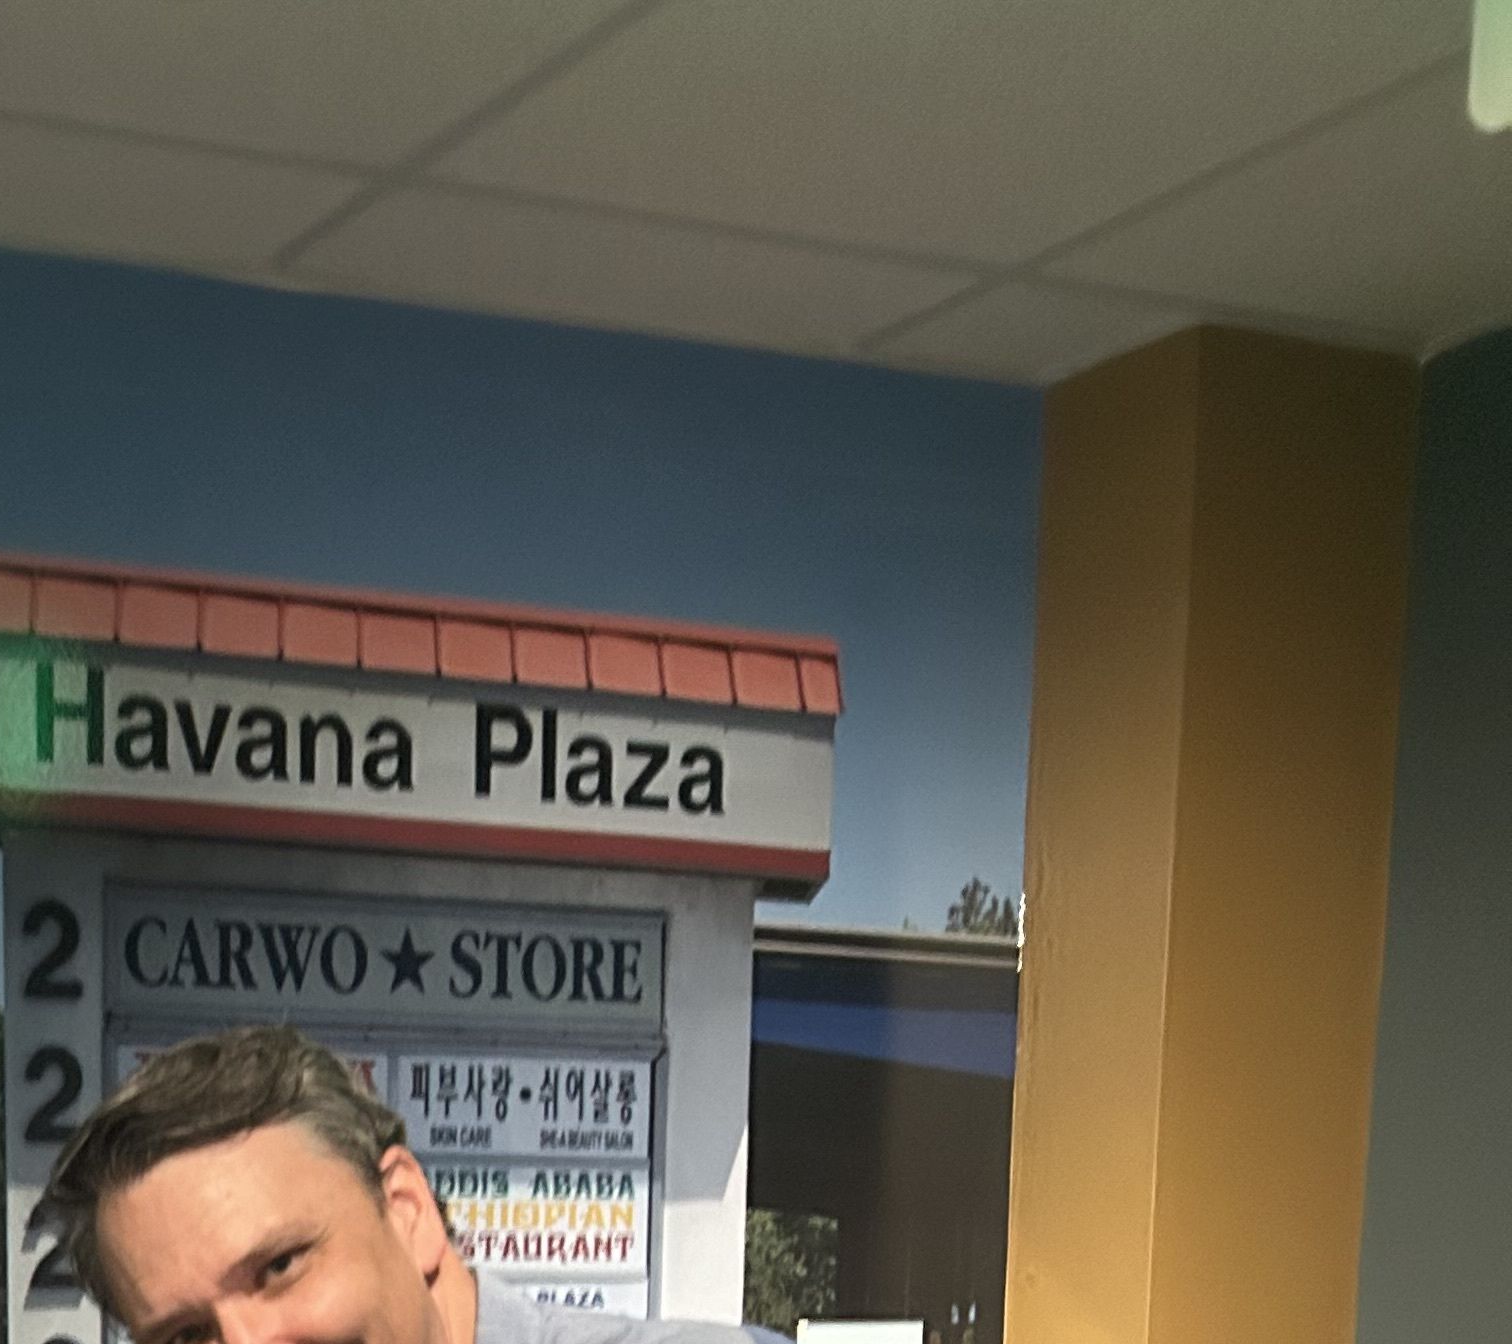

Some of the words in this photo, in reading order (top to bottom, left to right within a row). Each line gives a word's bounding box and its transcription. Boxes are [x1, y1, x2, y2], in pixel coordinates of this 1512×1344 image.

[34, 661, 416, 792] Havana
[472, 702, 726, 817] Plaza
[21, 899, 84, 1000] 2
[123, 914, 368, 995] CARWO
[447, 937, 644, 1004] STORE
[24, 1045, 83, 1144] 2
[434, 1168, 509, 1199] DDIS
[532, 1170, 634, 1199] ABABA
[445, 1201, 634, 1231] THIOPIAN
[455, 1230, 635, 1263] STAURANT
